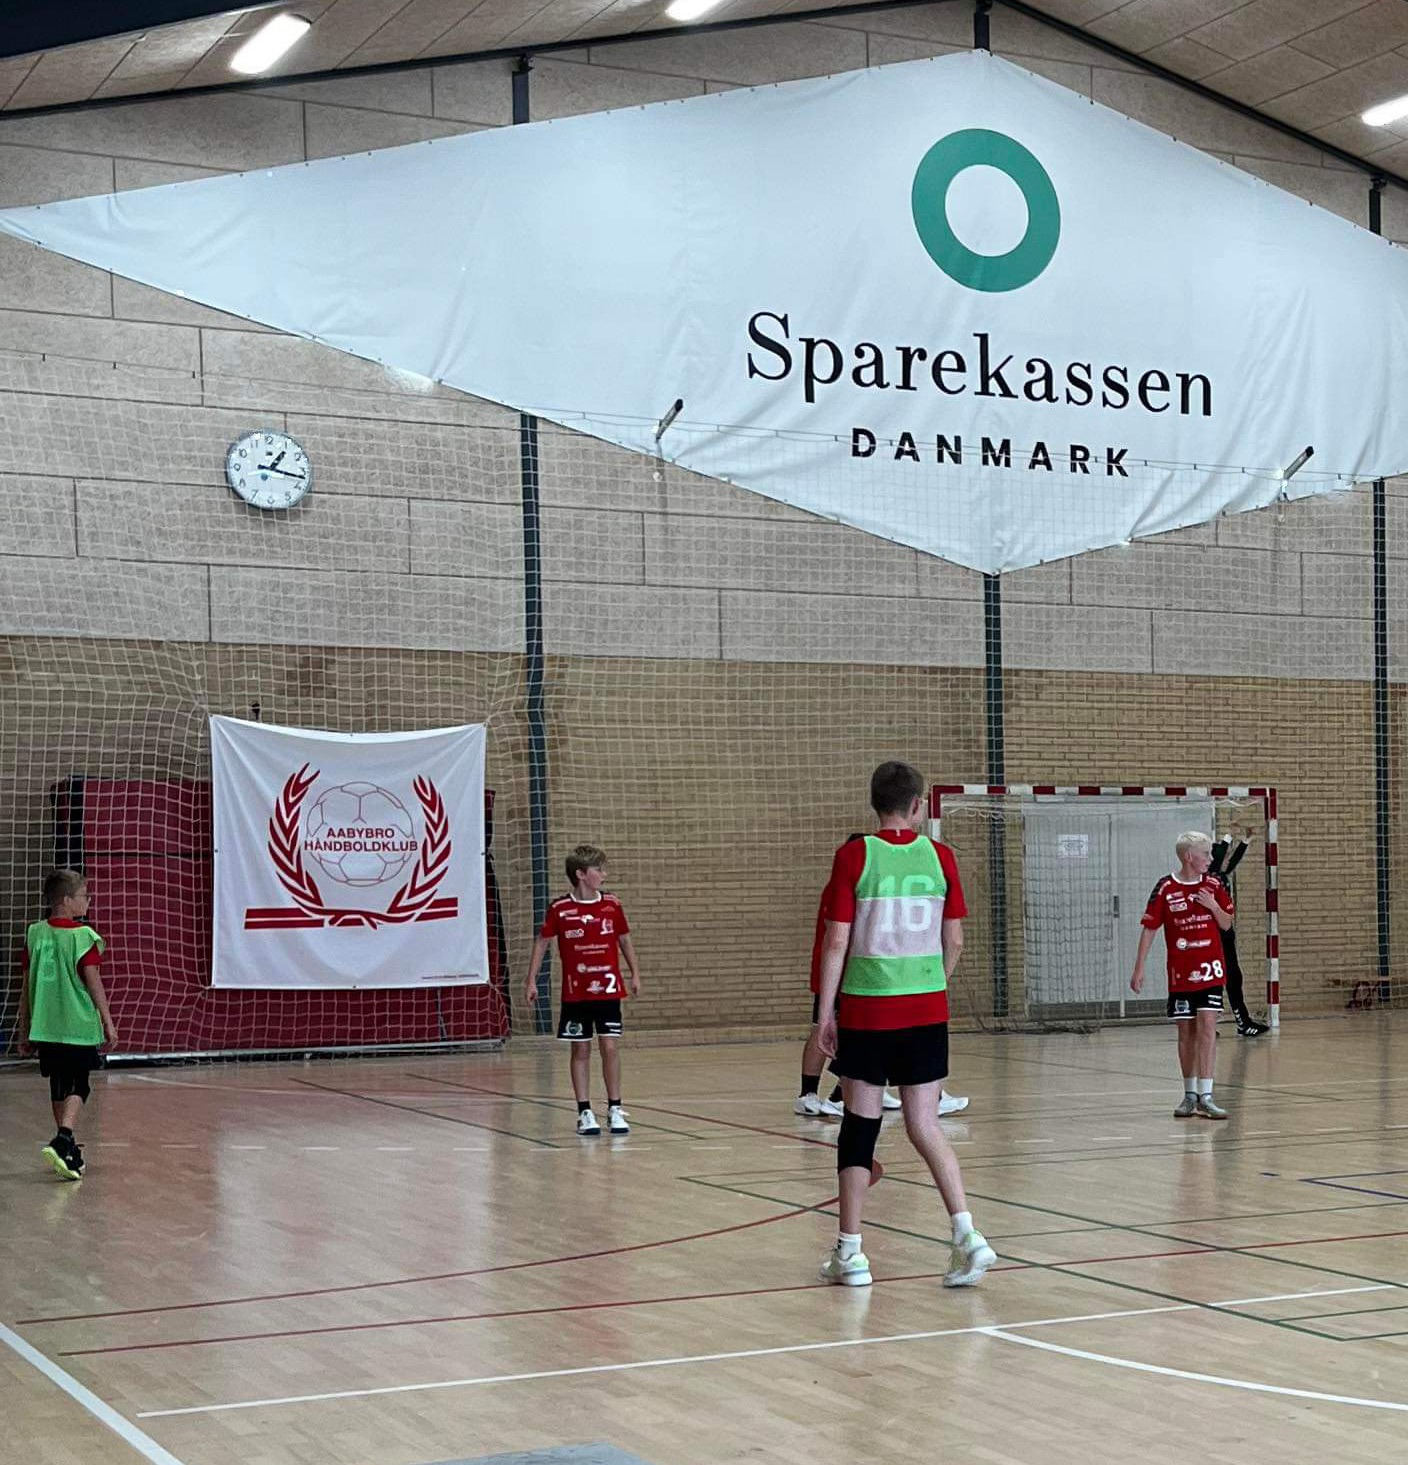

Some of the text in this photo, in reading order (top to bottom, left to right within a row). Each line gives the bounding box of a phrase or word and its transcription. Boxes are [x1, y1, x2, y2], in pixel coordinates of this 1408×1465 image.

[747, 311, 1215, 417] Sparekassen
[851, 427, 1130, 477] DANMARK
[327, 827, 395, 839] AABYBRO
[304, 838, 418, 852] HÅNDBOLDKLUB
[877, 874, 936, 932] 16
[1200, 959, 1224, 982] 28
[605, 972, 617, 993] 2
